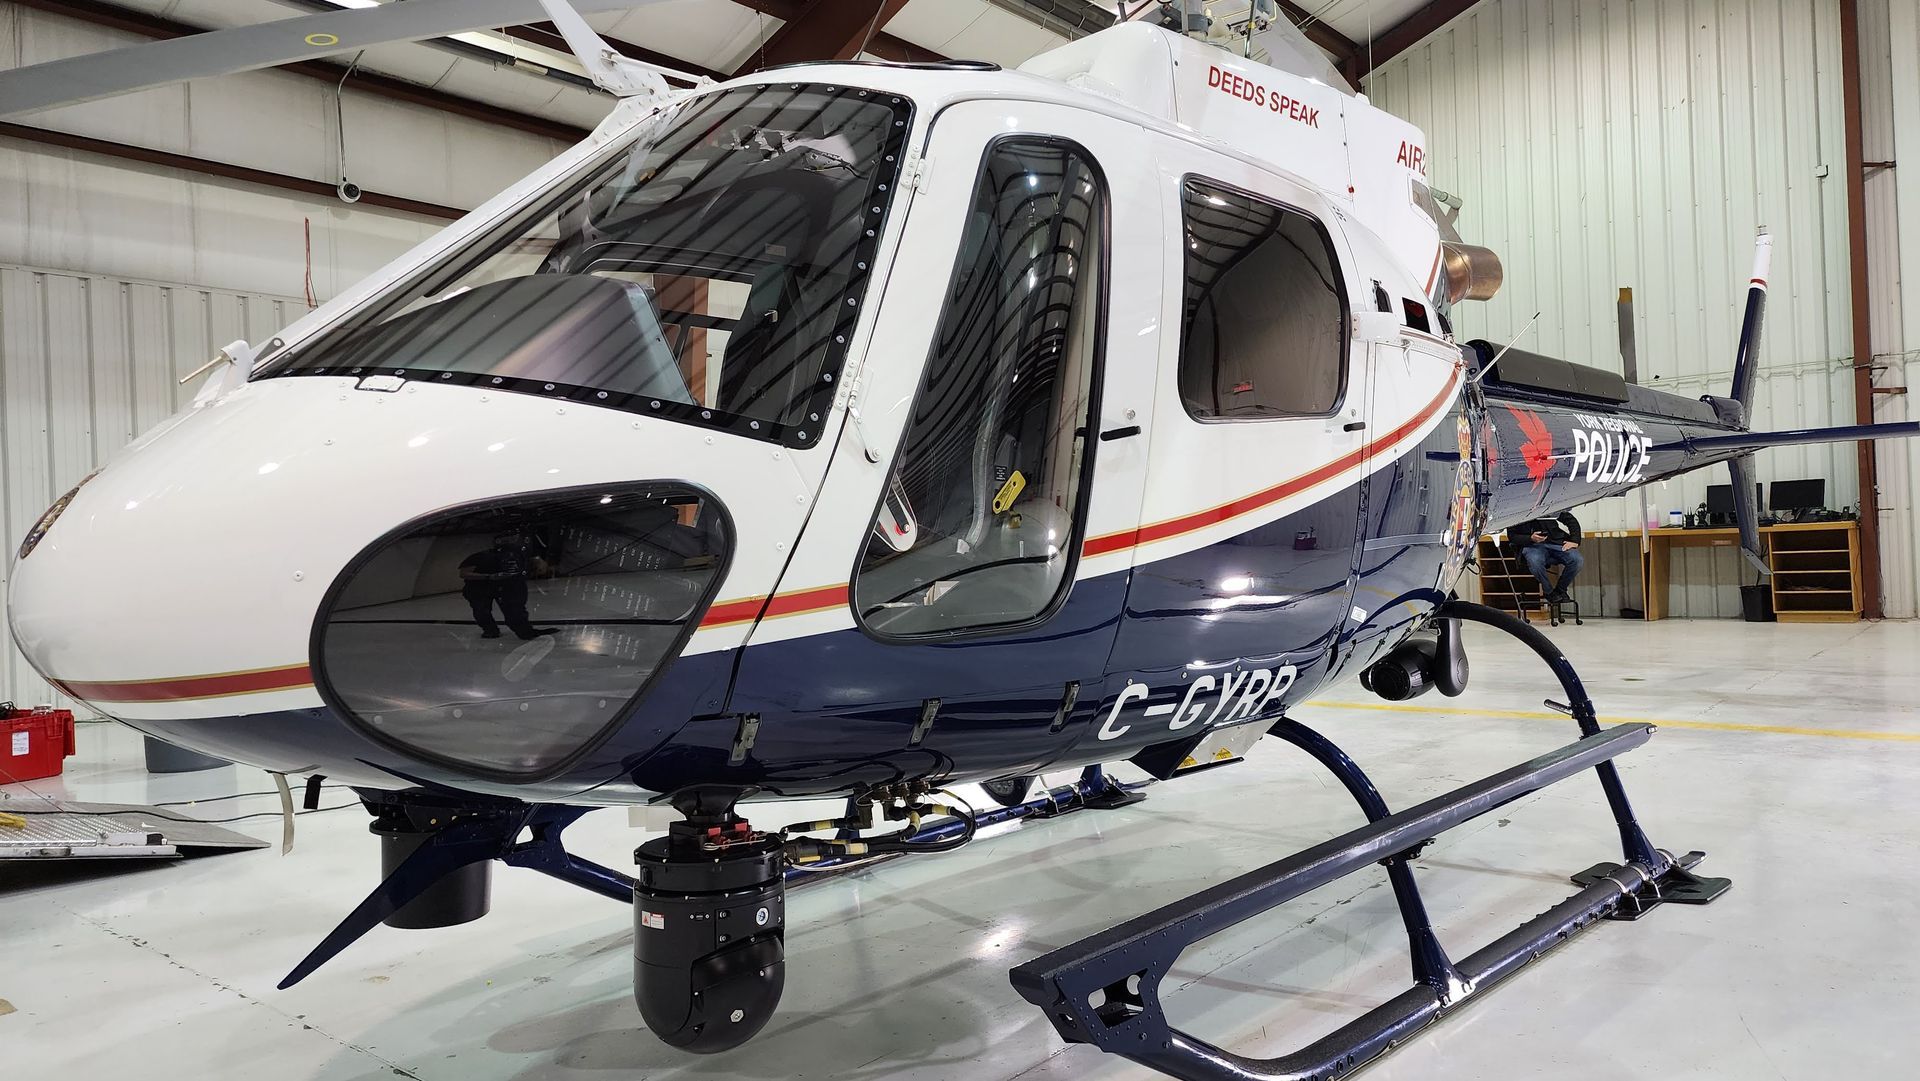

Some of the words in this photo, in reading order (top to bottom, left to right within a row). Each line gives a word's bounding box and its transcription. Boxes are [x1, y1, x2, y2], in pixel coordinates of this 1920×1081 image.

[1208, 65, 1265, 107] DEEDS
[1269, 91, 1320, 129] SPEAK
[1572, 412, 1604, 431] YORK
[1569, 428, 1653, 484] POLICE
[1097, 664, 1298, 741] C-GYRP
